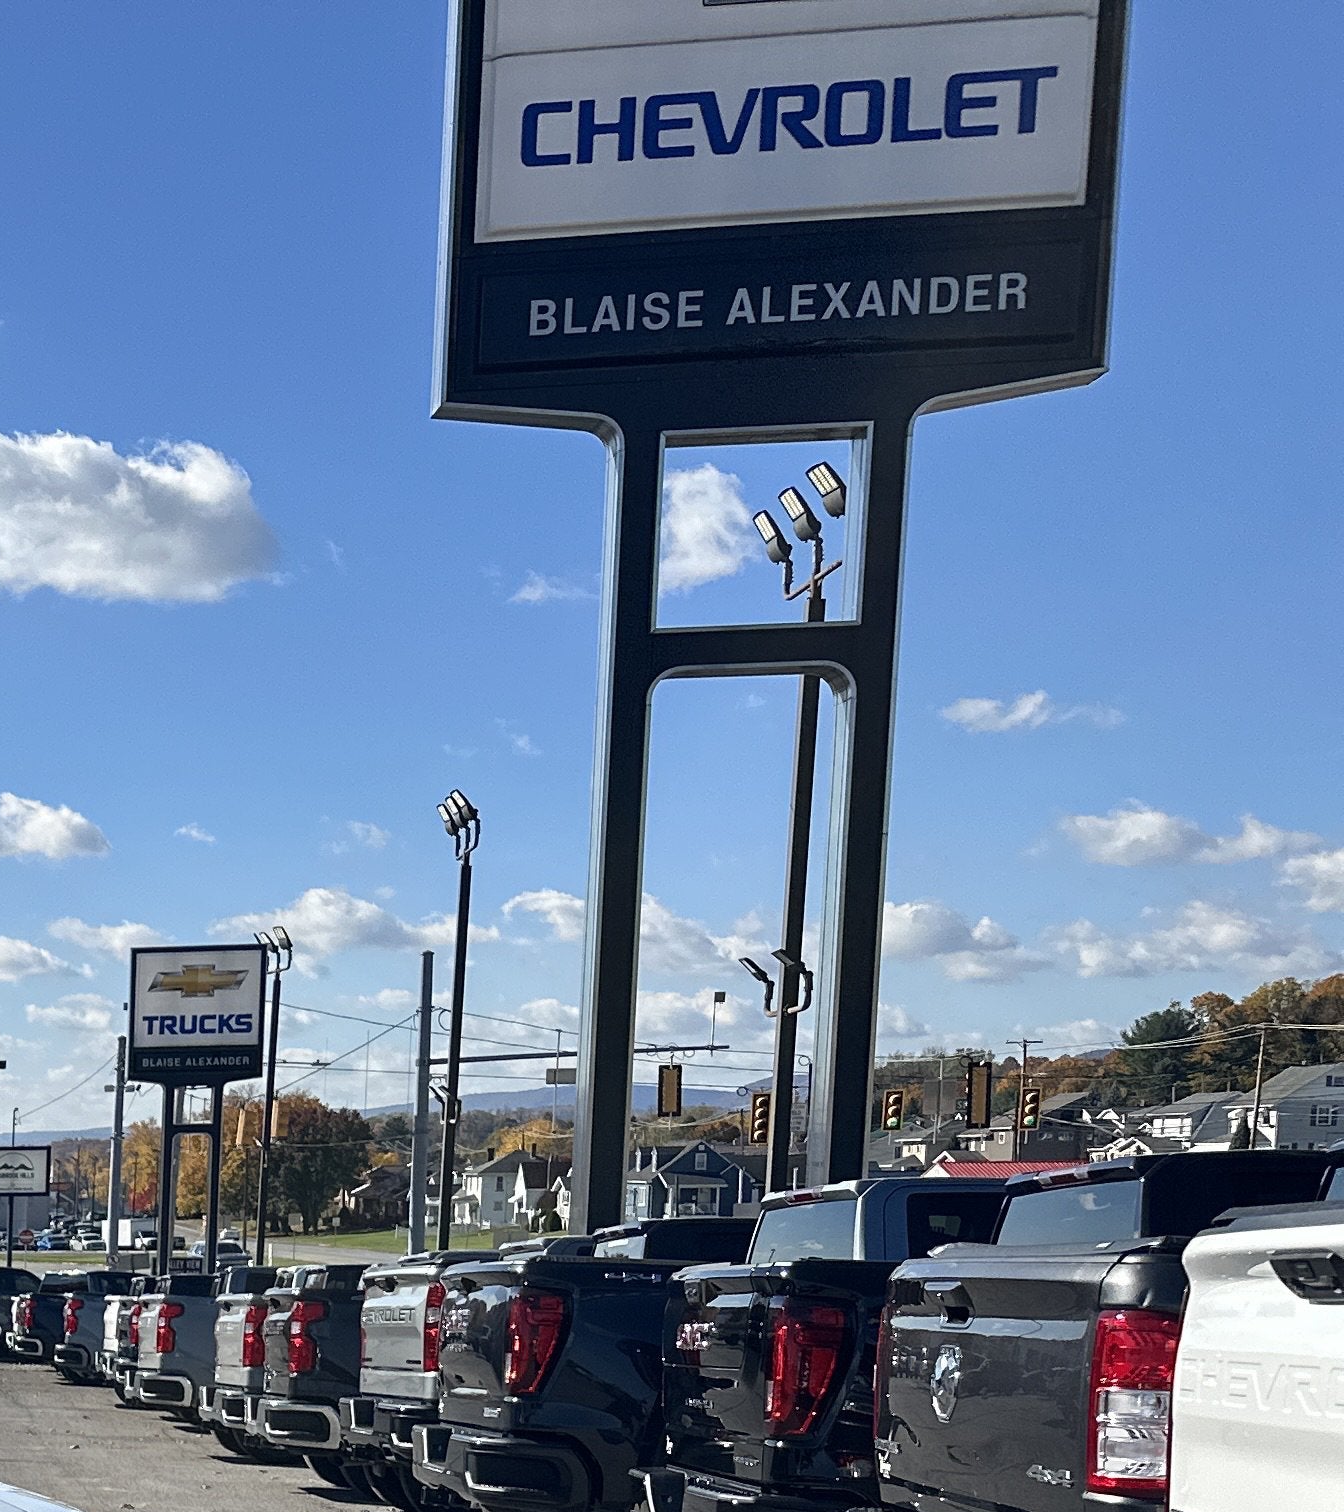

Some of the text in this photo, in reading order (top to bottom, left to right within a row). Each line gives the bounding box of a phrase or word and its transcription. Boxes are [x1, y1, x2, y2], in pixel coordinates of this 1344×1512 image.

[520, 65, 1059, 167] CHEVROLET
[528, 271, 1030, 337] BLAISE ALEXANDER
[142, 1013, 253, 1035] TRUCKS
[142, 1056, 250, 1068] BLAISE ALEXANDER
